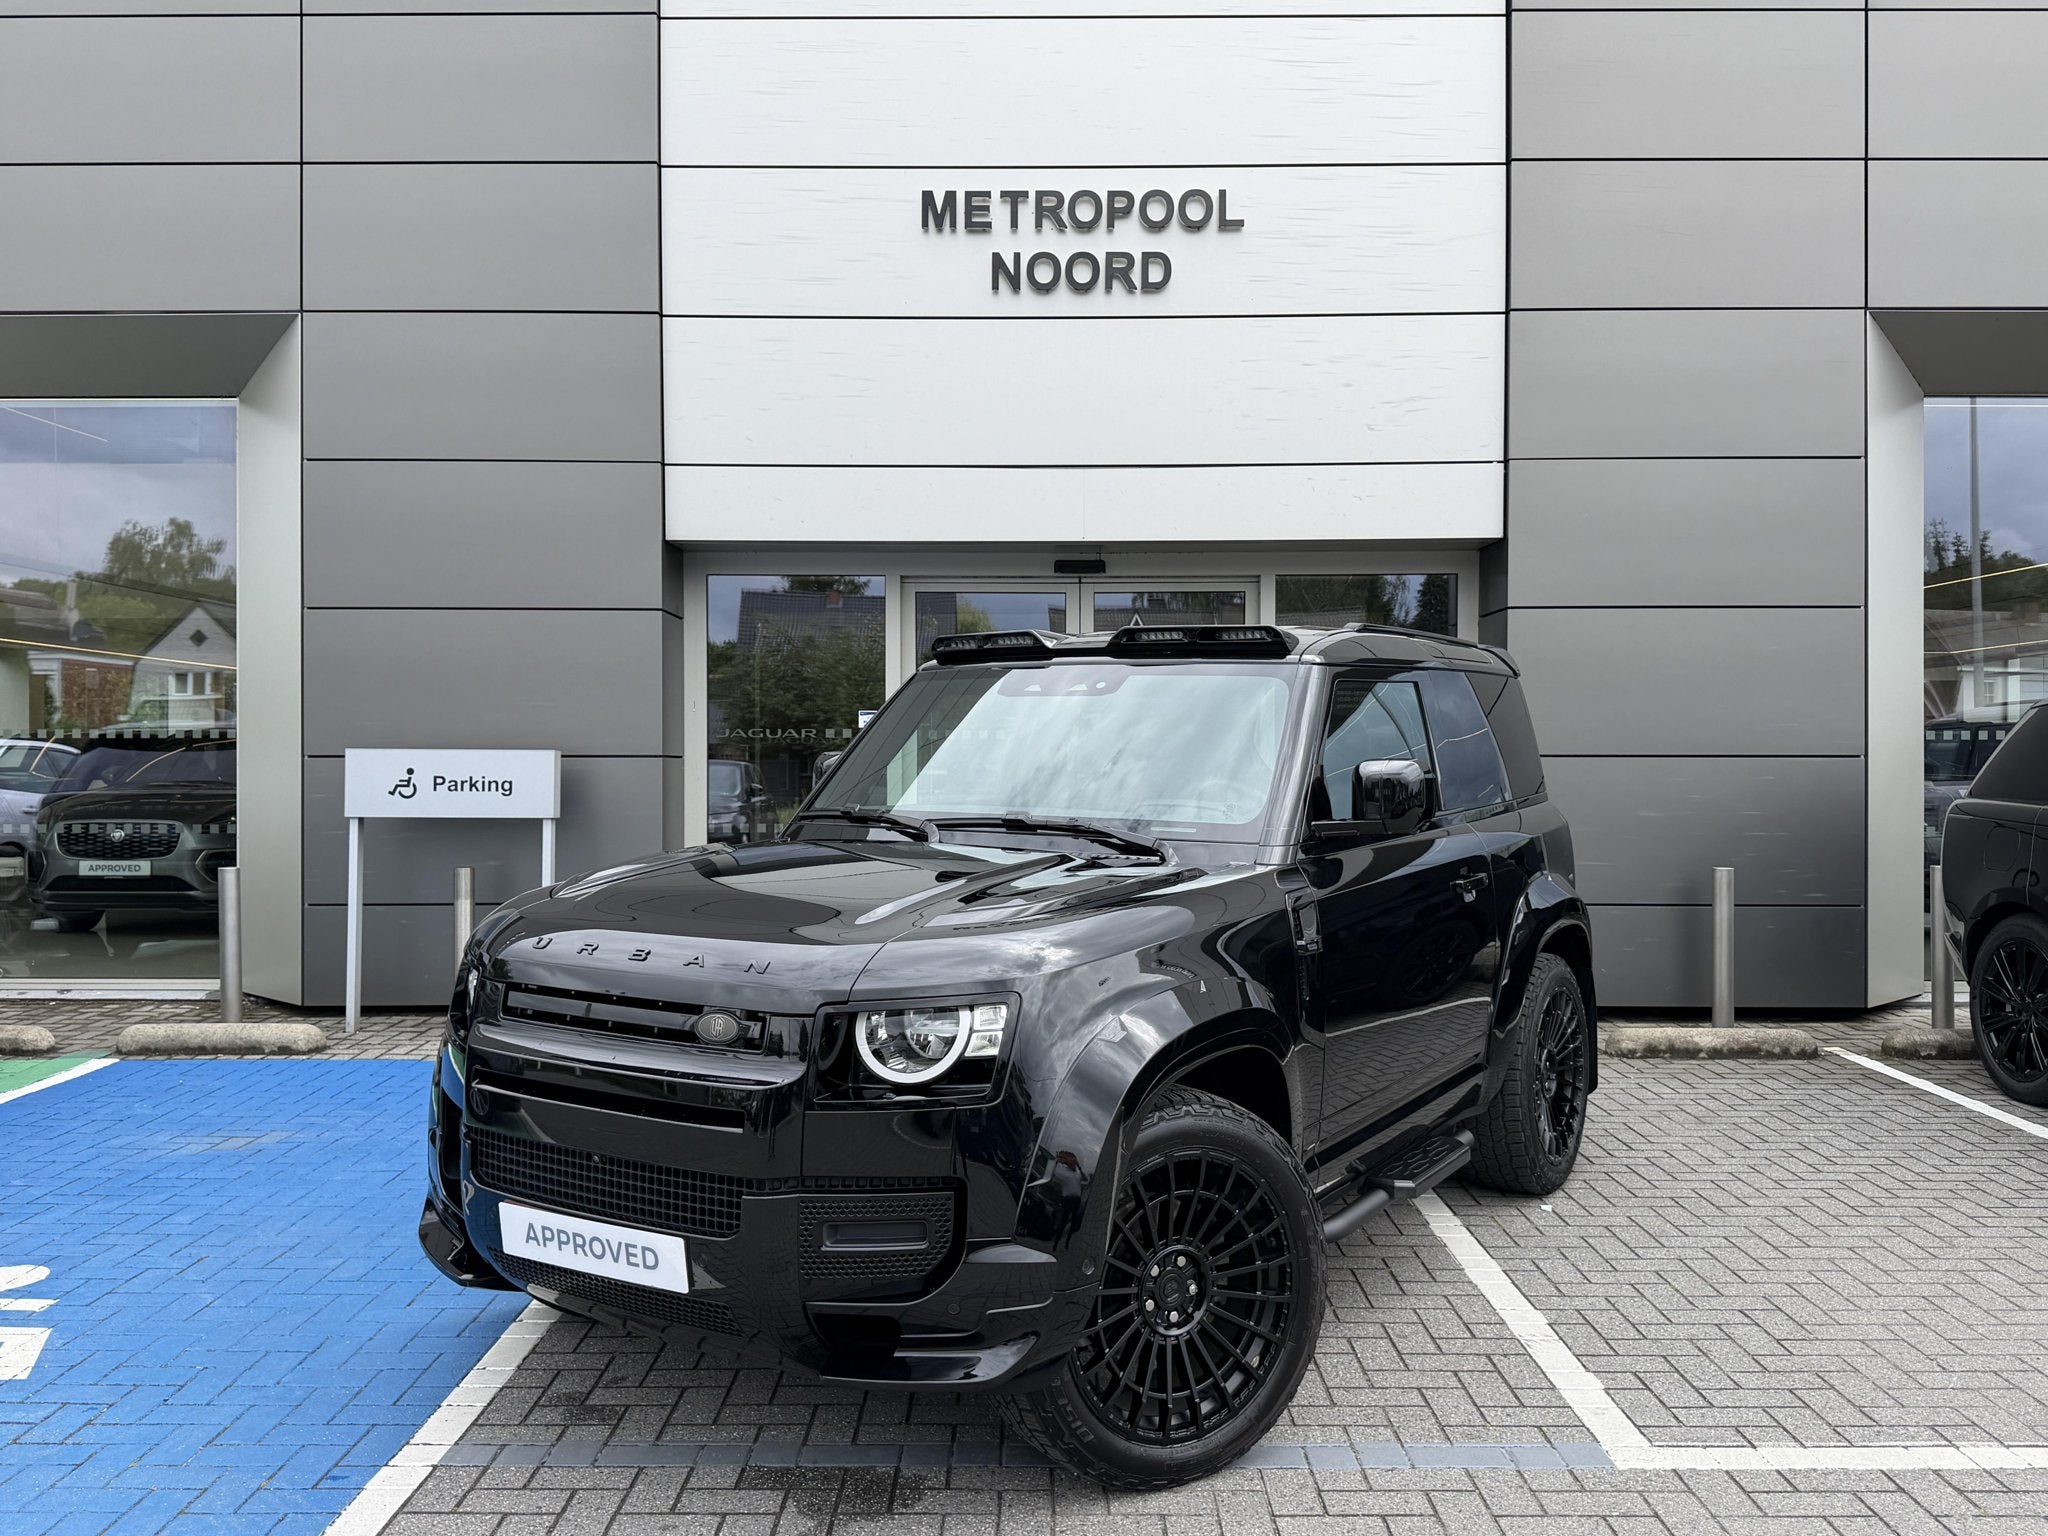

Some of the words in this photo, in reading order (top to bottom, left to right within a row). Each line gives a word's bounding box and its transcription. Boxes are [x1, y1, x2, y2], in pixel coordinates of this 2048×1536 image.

[921, 188, 1245, 233] METROPOOL
[991, 251, 1172, 293] NOORD
[716, 728, 817, 738] JAGUAR
[432, 775, 513, 797] Parking
[88, 864, 141, 872] APPROVED
[532, 936, 771, 974] URBAN
[525, 1222, 660, 1271] APPROVED
